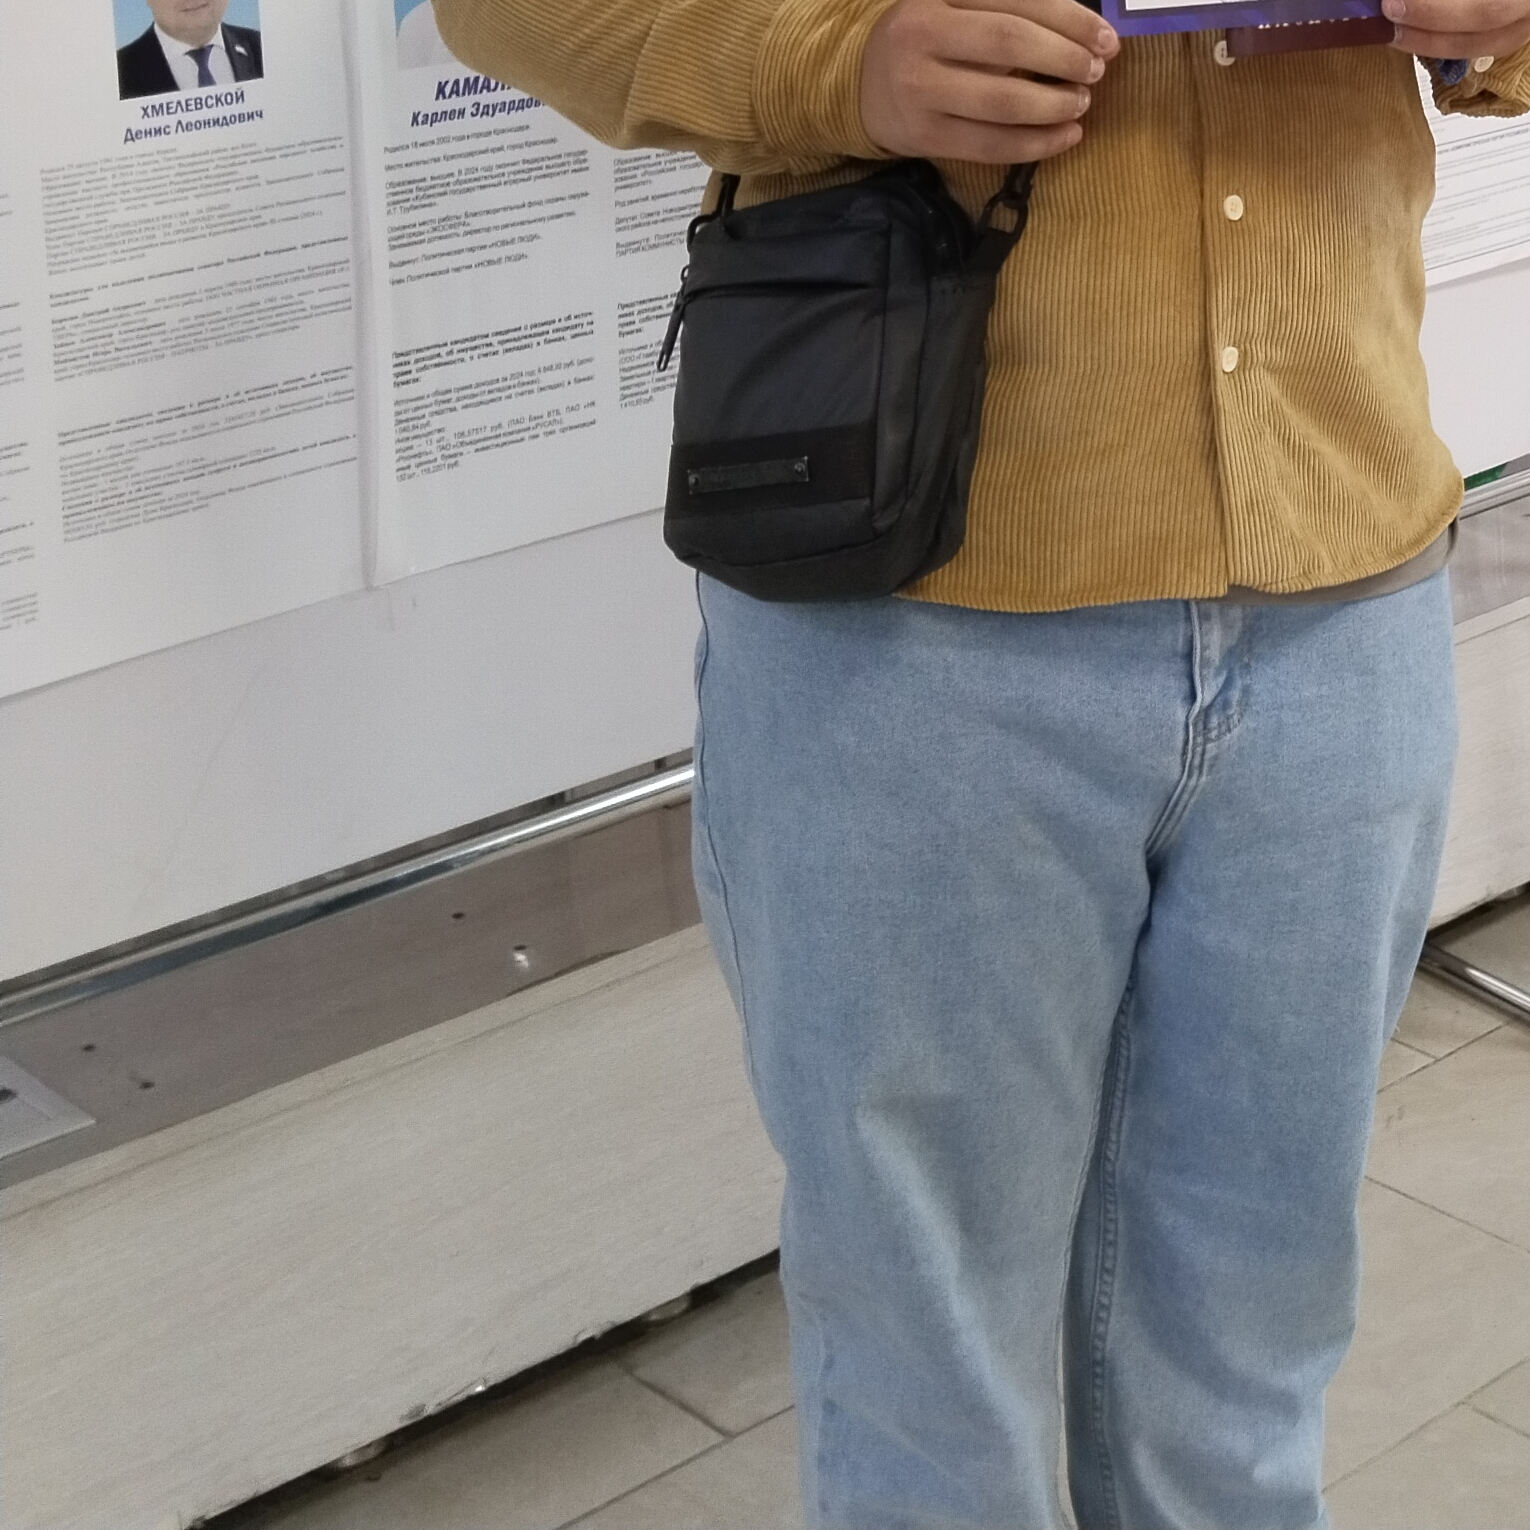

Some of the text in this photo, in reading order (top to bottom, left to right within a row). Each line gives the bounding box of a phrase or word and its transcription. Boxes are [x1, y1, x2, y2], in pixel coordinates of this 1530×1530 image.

[434, 74, 513, 102] КАМАЛ
[140, 87, 245, 120] ХМЕЛЕВСКОЙ
[470, 96, 545, 118] Эдуардов
[123, 108, 264, 145] Денис Леонидович
